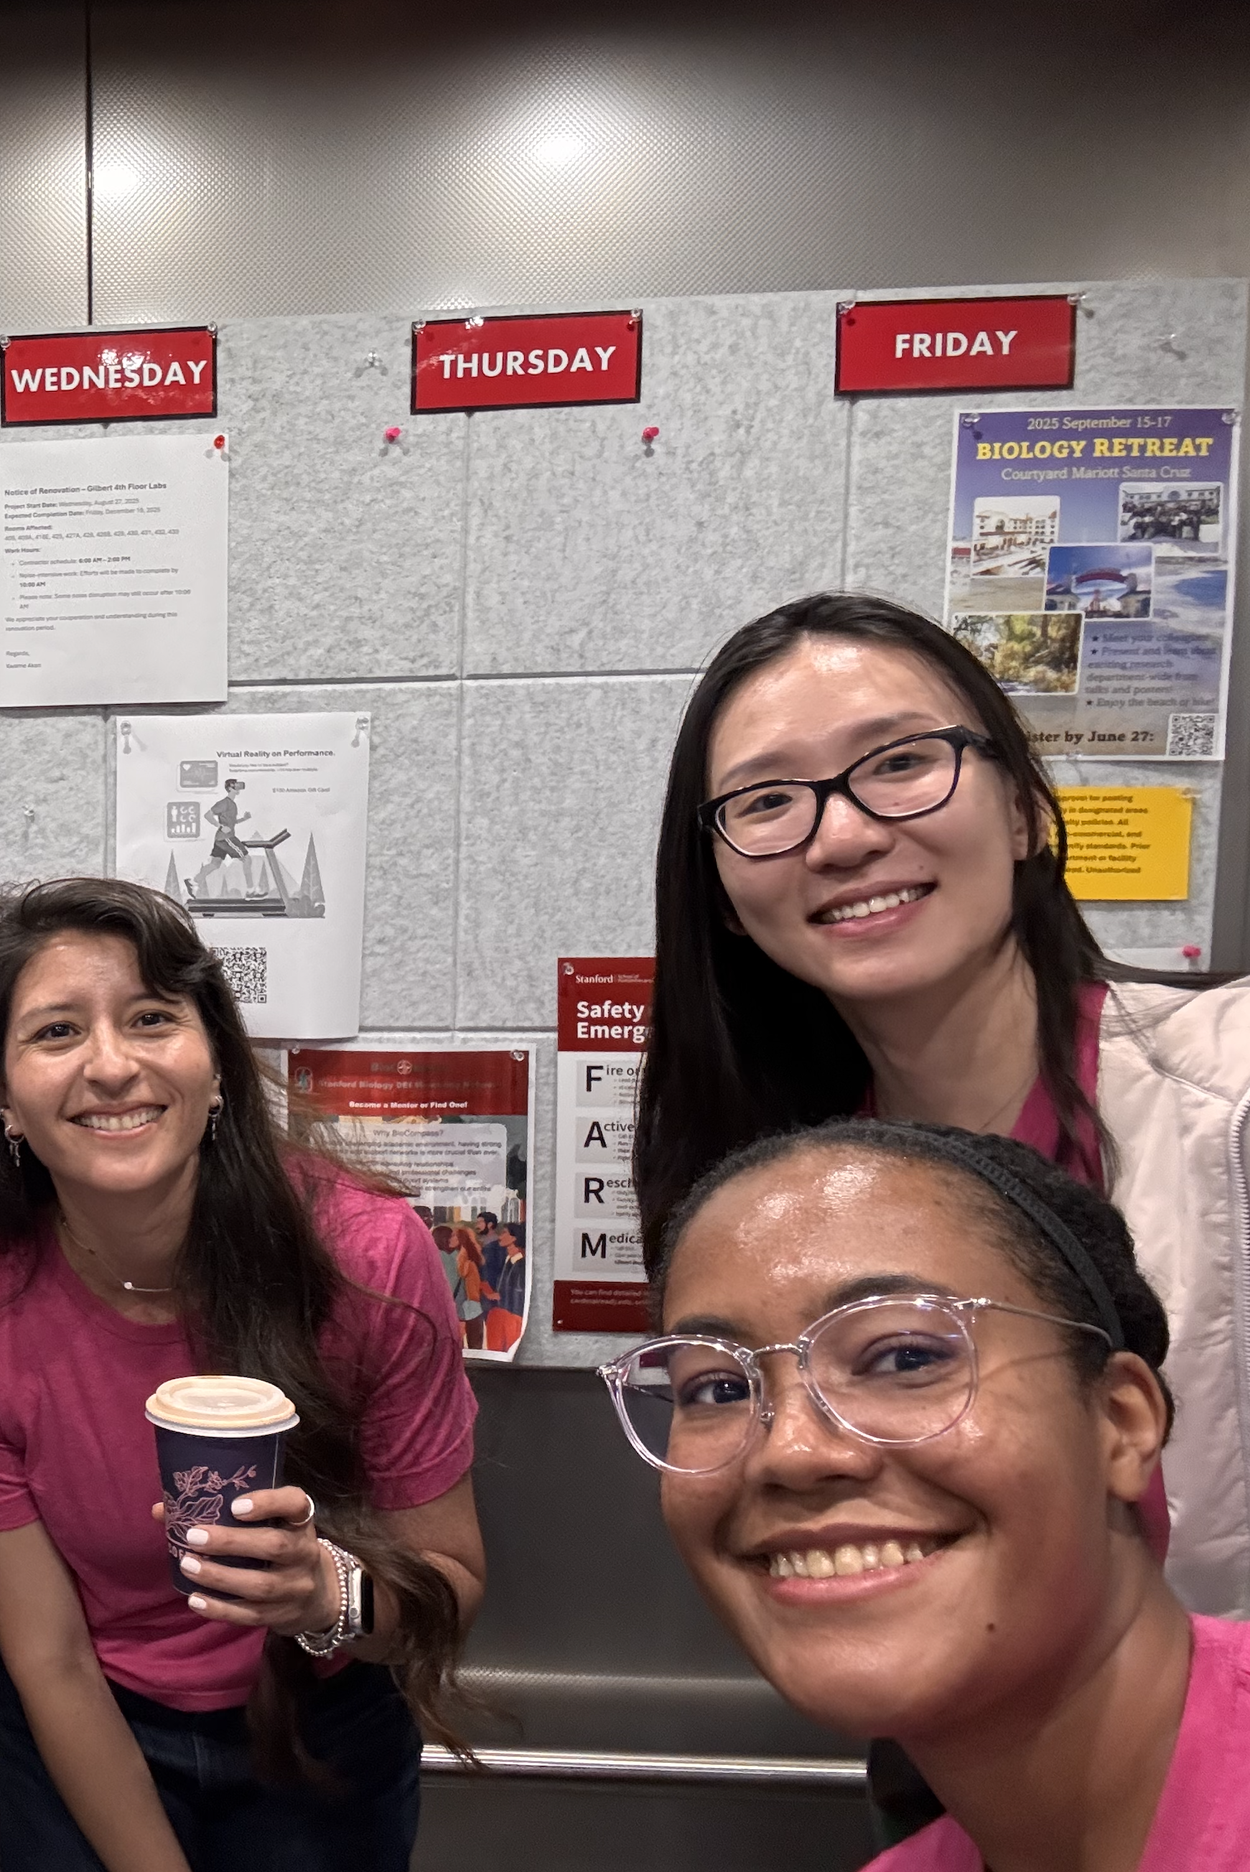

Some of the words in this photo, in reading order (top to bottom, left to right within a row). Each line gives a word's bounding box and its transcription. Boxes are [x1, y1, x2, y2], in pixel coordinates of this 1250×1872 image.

[895, 330, 1018, 359] FRIDAY
[439, 346, 617, 379] THURSDAY
[11, 360, 207, 392] WEDNESDAY
[1027, 418, 1059, 430] 2025
[1062, 417, 1132, 432] September
[1136, 416, 1172, 428] 15-17
[976, 440, 1086, 460] BIOLOGY
[1093, 438, 1214, 457] RETREAT
[1001, 468, 1068, 483] Courtyard
[1071, 467, 1119, 479] Mariott
[1123, 467, 1156, 478] Santa
[1160, 467, 1191, 478] Cruz
[39, 487, 81, 495] Renovation
[149, 482, 167, 490] Labs
[1028, 730, 1060, 742] ister
[1064, 729, 1084, 745] by
[1087, 730, 1126, 743] June
[1130, 731, 1154, 742] 27:
[244, 750, 271, 759] Reality
[283, 749, 336, 757] Performance.
[576, 974, 613, 984] Stanford
[576, 1000, 645, 1023] Safety
[576, 1022, 647, 1044] Emerg
[390, 1101, 419, 1109] Mentor
[373, 1129, 390, 1138] Why
[581, 1232, 643, 1259] Medica
